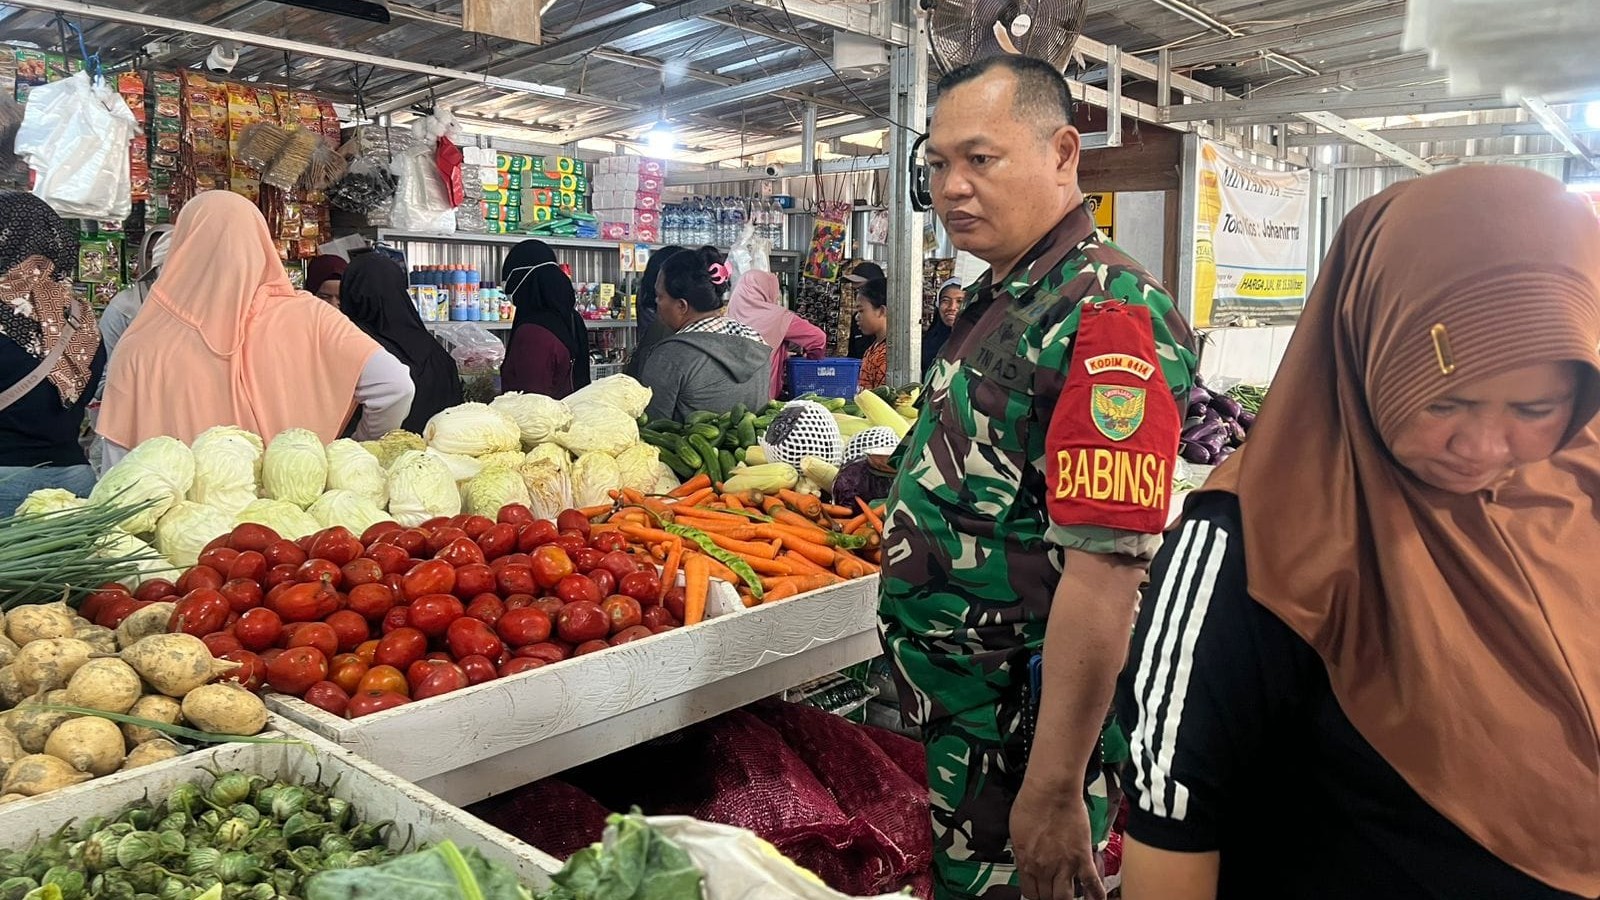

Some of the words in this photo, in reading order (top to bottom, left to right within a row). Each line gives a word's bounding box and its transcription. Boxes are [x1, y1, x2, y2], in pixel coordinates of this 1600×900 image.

[1240, 279, 1264, 290] HARGA
[1089, 357, 1123, 371] KODIM
[1056, 449, 1167, 510] BABINSA
